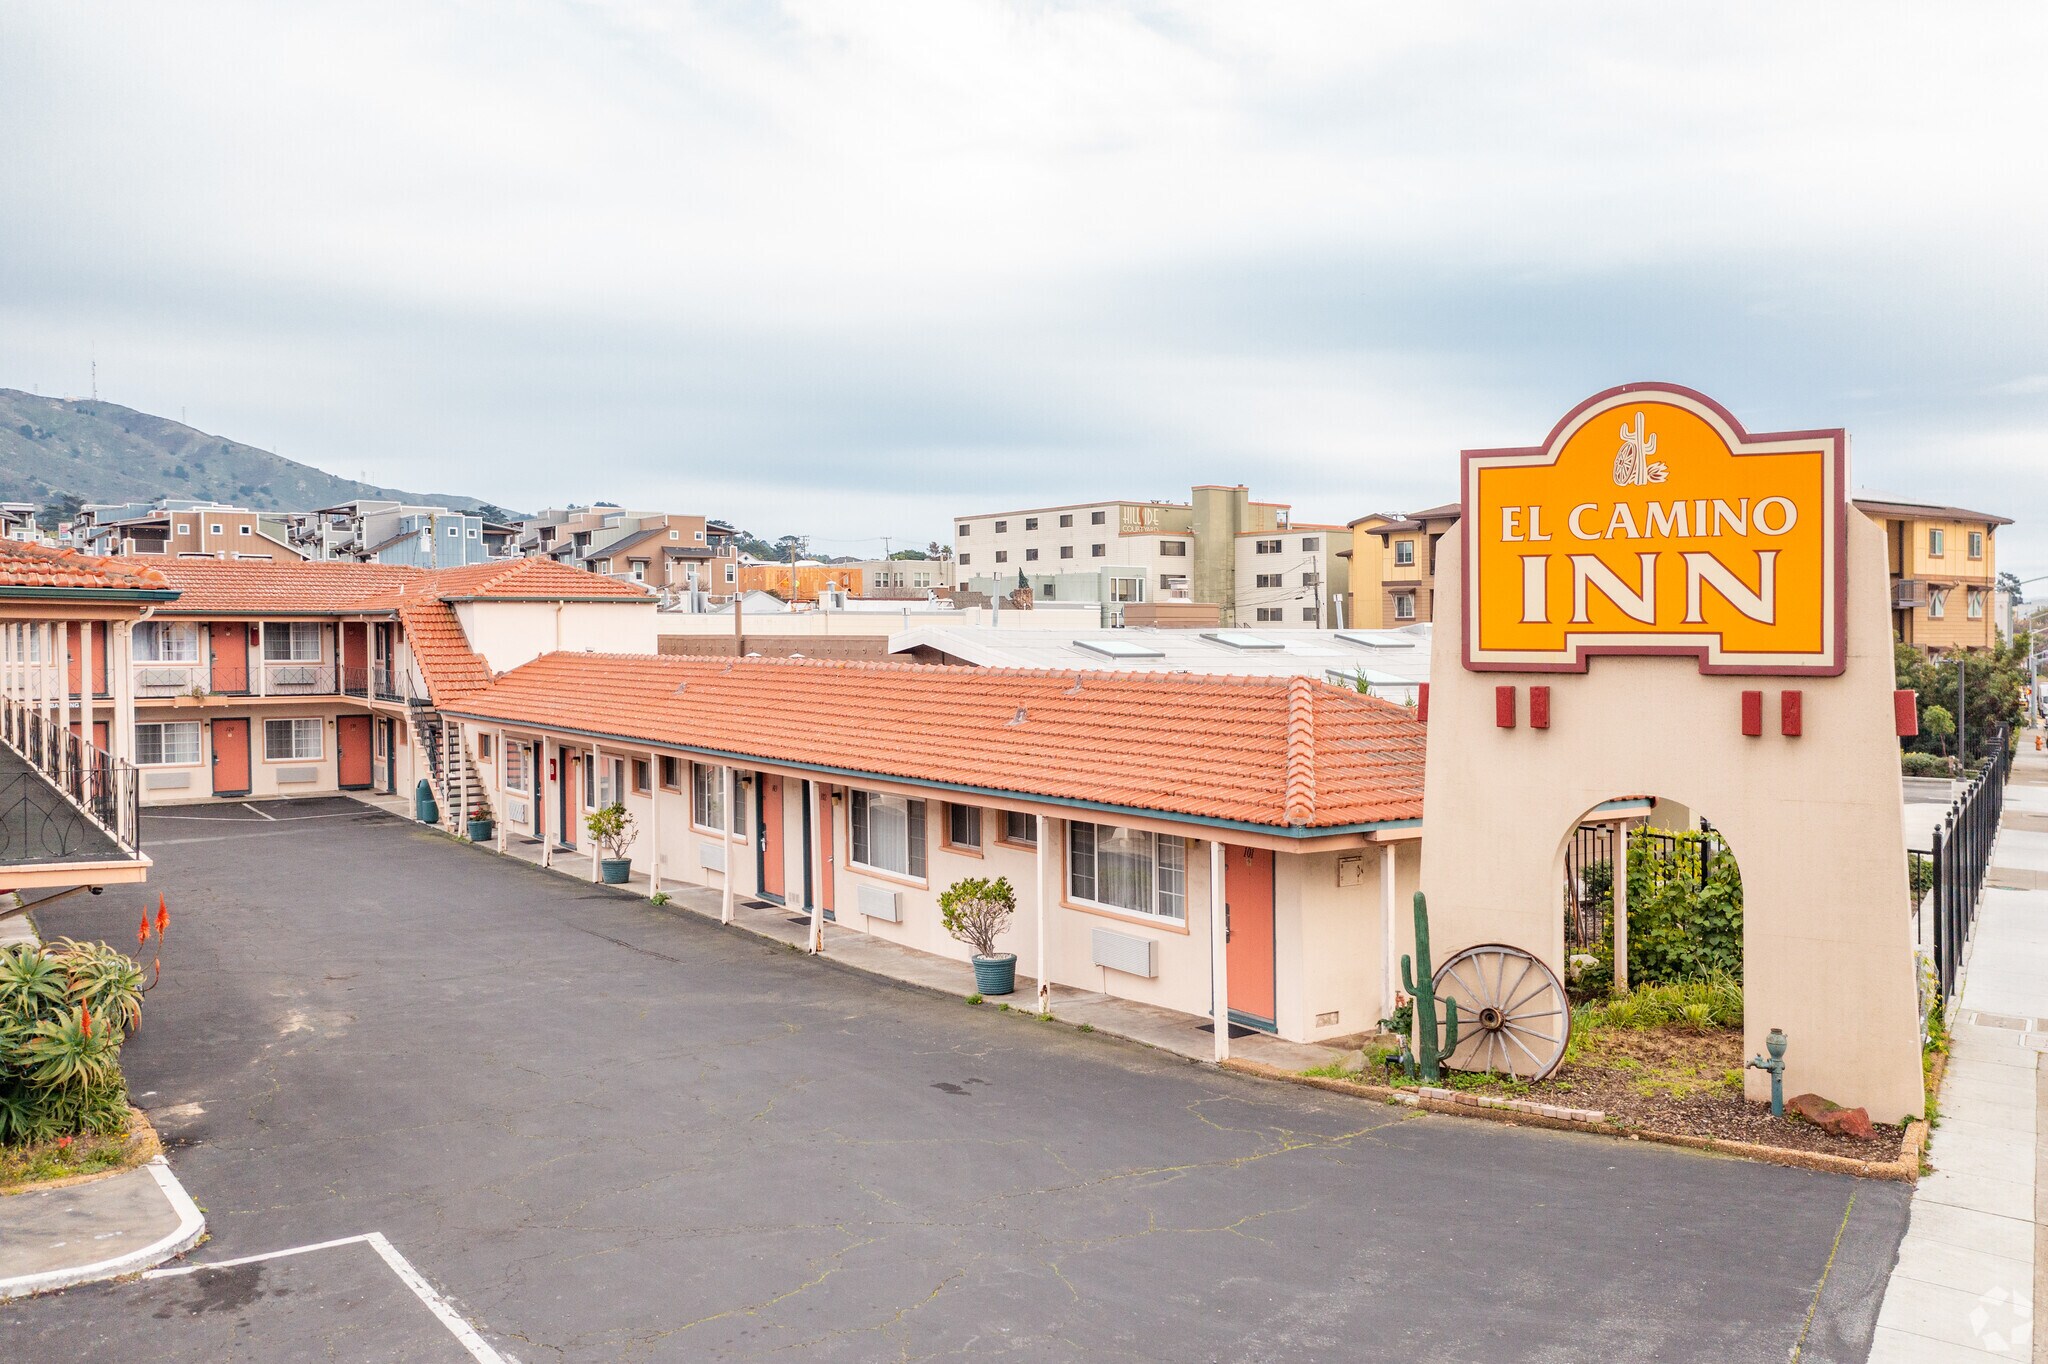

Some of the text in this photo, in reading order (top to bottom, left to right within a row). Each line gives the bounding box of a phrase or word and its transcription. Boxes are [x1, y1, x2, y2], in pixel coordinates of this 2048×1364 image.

[1123, 506, 1159, 527] HILLSIDE
[1500, 495, 1798, 542] EL CAMINO
[1518, 549, 1782, 626] INN
